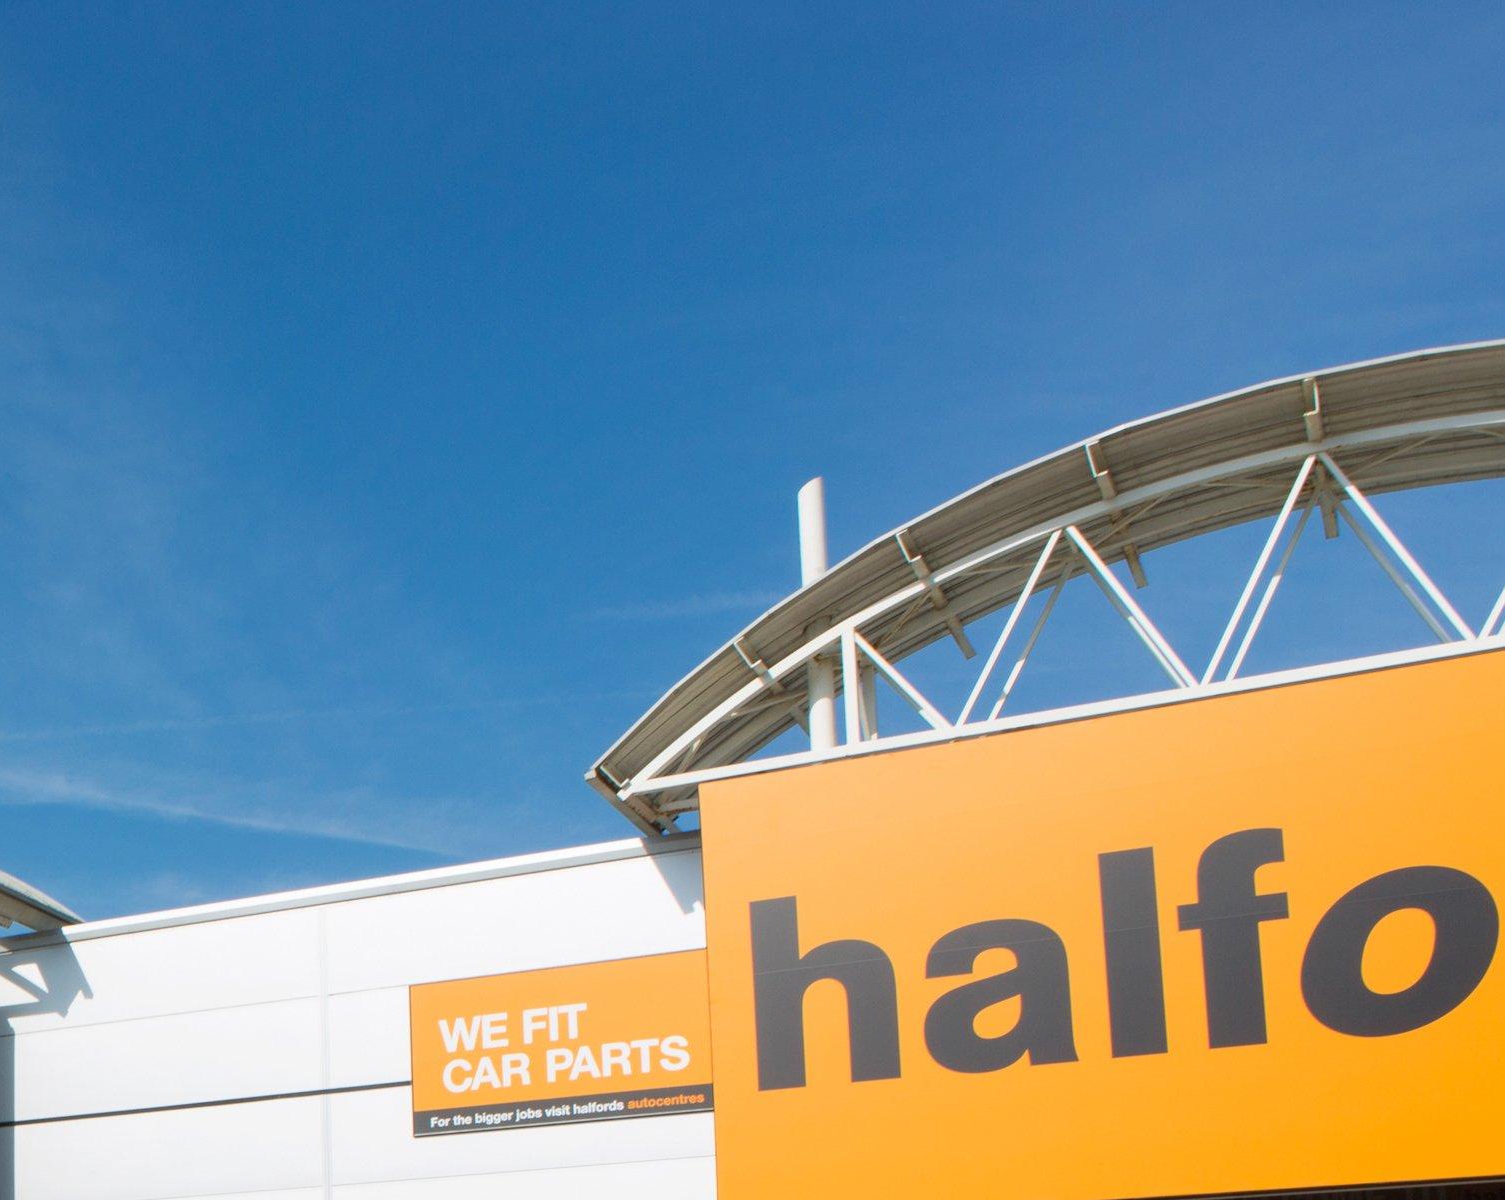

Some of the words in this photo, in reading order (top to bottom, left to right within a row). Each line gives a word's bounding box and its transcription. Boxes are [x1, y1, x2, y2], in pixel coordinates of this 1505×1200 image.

[749, 827, 1499, 1092] halfo
[438, 1012, 510, 1054] WE
[522, 1003, 588, 1045] FIT
[442, 1052, 532, 1094] CAR
[546, 1035, 691, 1083] PARTS
[430, 1115, 450, 1128] For
[452, 1113, 472, 1127] the
[475, 1108, 514, 1125] bigger
[515, 1107, 543, 1122] jobs
[545, 1104, 571, 1118] visit
[573, 1099, 625, 1116] halfords
[627, 1092, 705, 1111] autocentres
